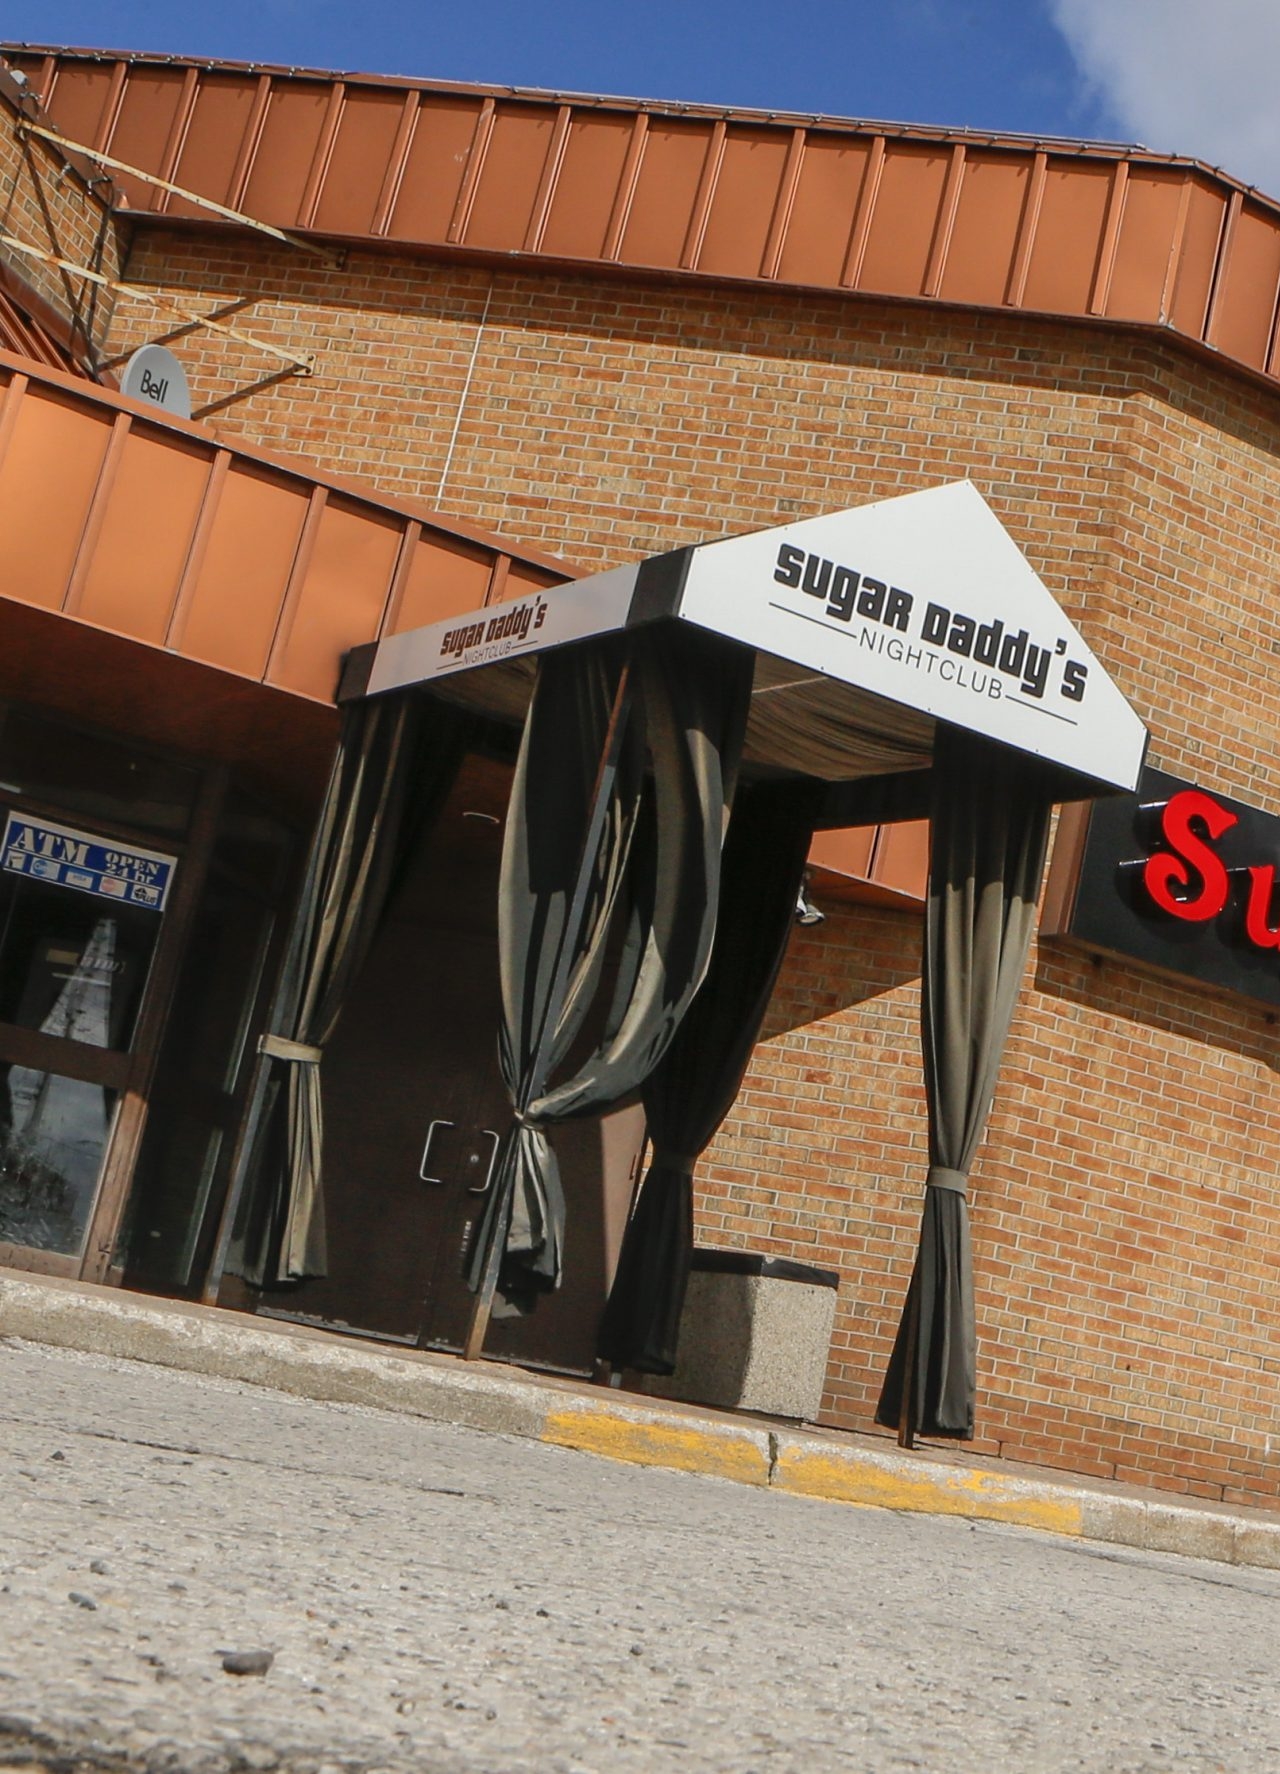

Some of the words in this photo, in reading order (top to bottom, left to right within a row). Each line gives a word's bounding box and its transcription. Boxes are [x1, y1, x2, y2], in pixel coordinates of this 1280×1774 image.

[140, 369, 169, 404] Bell
[463, 641, 512, 665] NIGHTCLUB
[859, 627, 1004, 700] NIGHTCLUB
[920, 601, 1088, 702] Daddy's
[9, 827, 90, 867] ATM
[105, 851, 160, 875] OPEN
[105, 863, 129, 878] 24
